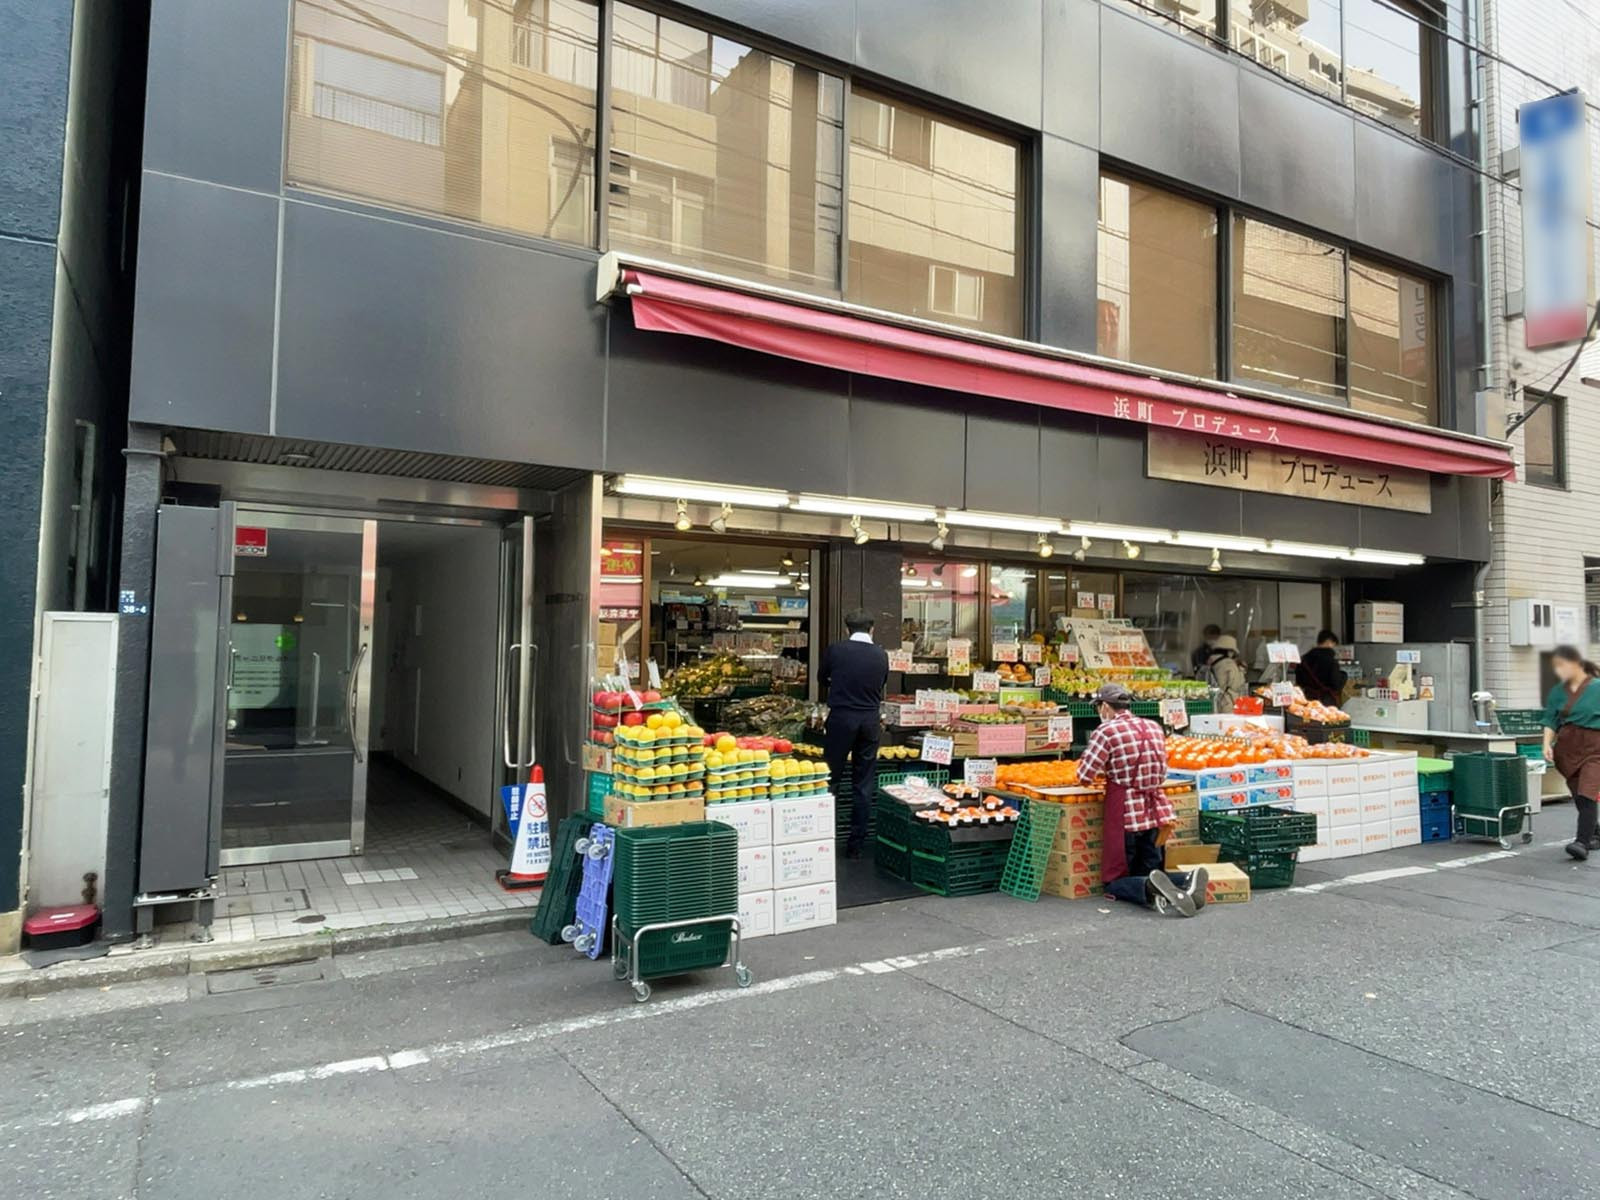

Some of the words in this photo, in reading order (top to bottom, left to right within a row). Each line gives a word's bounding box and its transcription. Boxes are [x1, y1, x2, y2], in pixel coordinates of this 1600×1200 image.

[1113, 396, 1153, 425] 浜町
[1172, 409, 1280, 443] プロデュース
[1203, 441, 1252, 481] 浜町
[1280, 456, 1393, 498] プロデュース
[528, 836, 550, 850] 禁止
